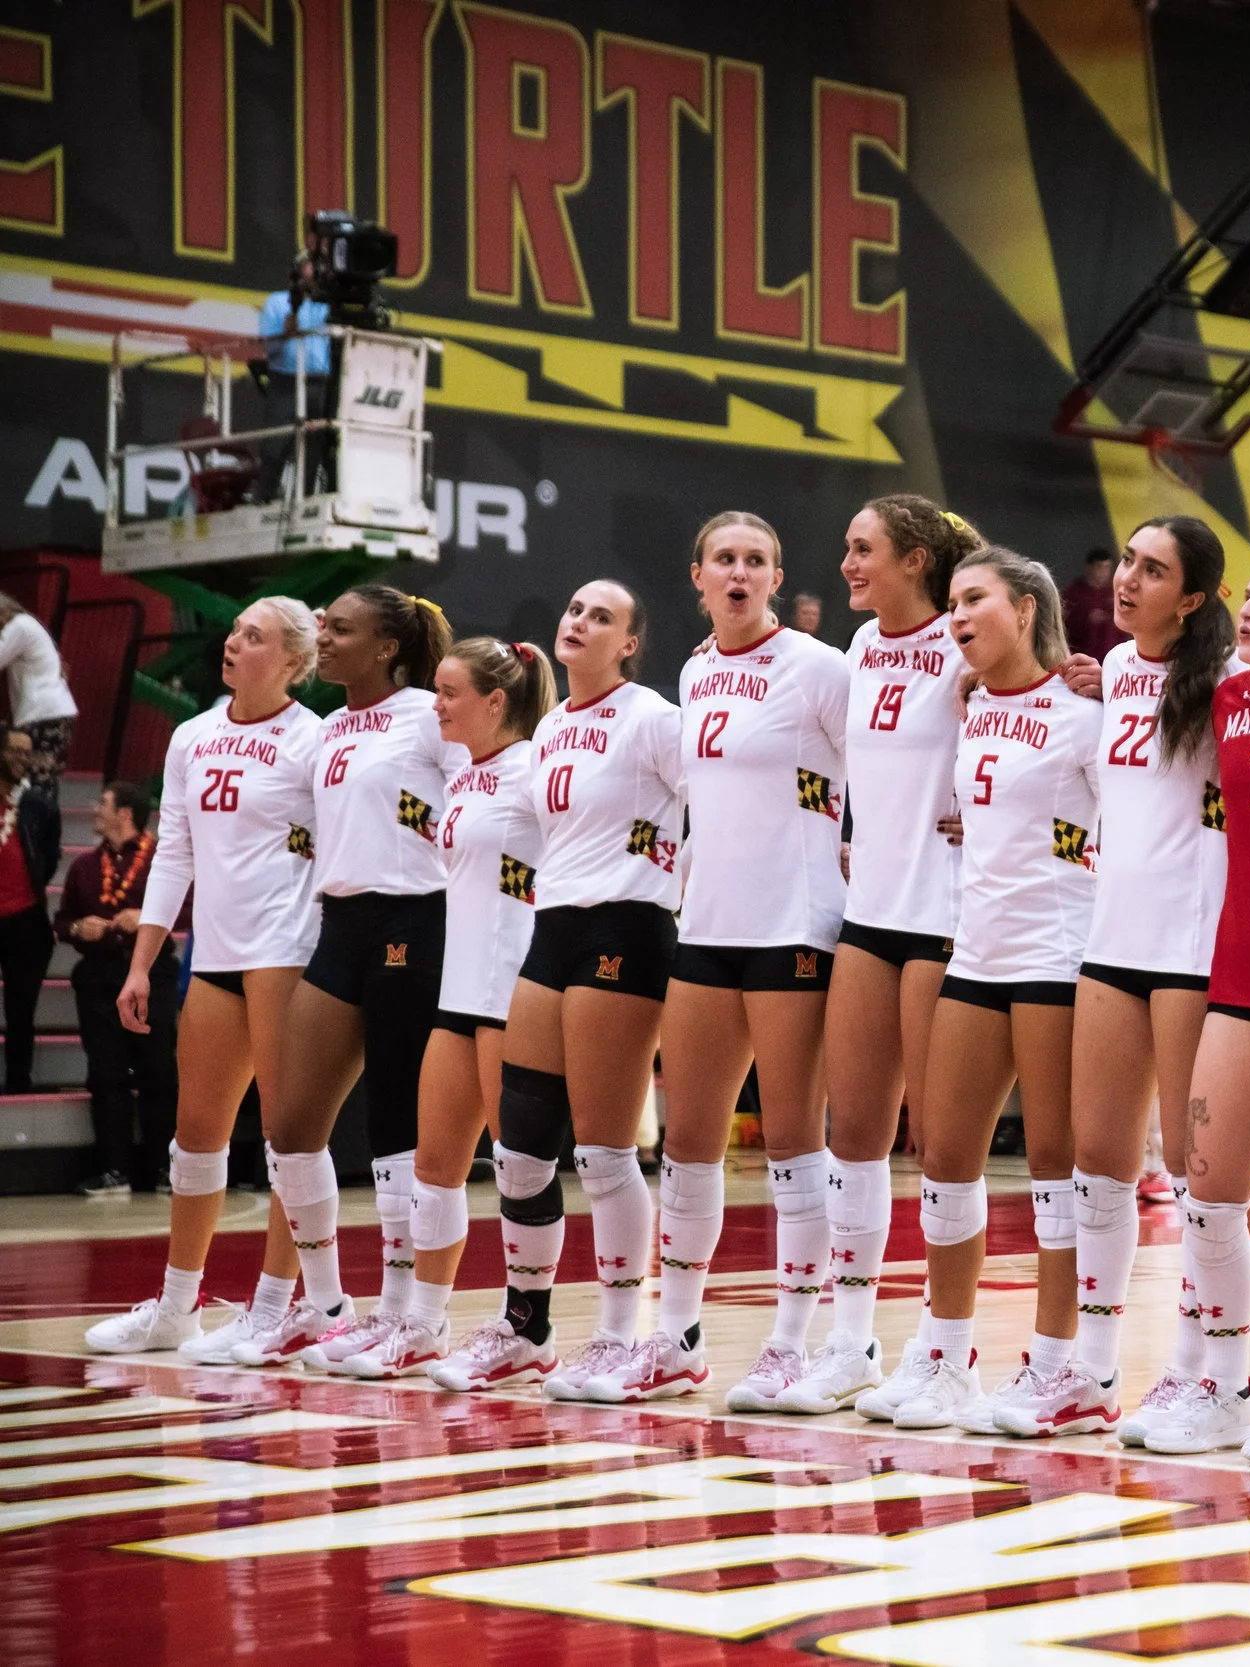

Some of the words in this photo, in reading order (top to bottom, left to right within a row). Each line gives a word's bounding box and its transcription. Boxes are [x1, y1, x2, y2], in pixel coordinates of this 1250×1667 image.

[132, 0, 907, 366] TURTLE
[354, 384, 405, 410] JLG
[688, 671, 768, 704] MARYLAND
[869, 684, 907, 731] 19
[192, 735, 277, 766] MARYLAND
[540, 726, 607, 765] MARYLAND
[697, 711, 729, 758] 12
[964, 711, 1049, 750] MARYLAND
[1108, 714, 1158, 767] 22
[324, 744, 357, 788] 16
[973, 754, 999, 805] 5
[200, 768, 244, 812] 26
[547, 764, 574, 813] 10
[443, 805, 464, 849] 8
